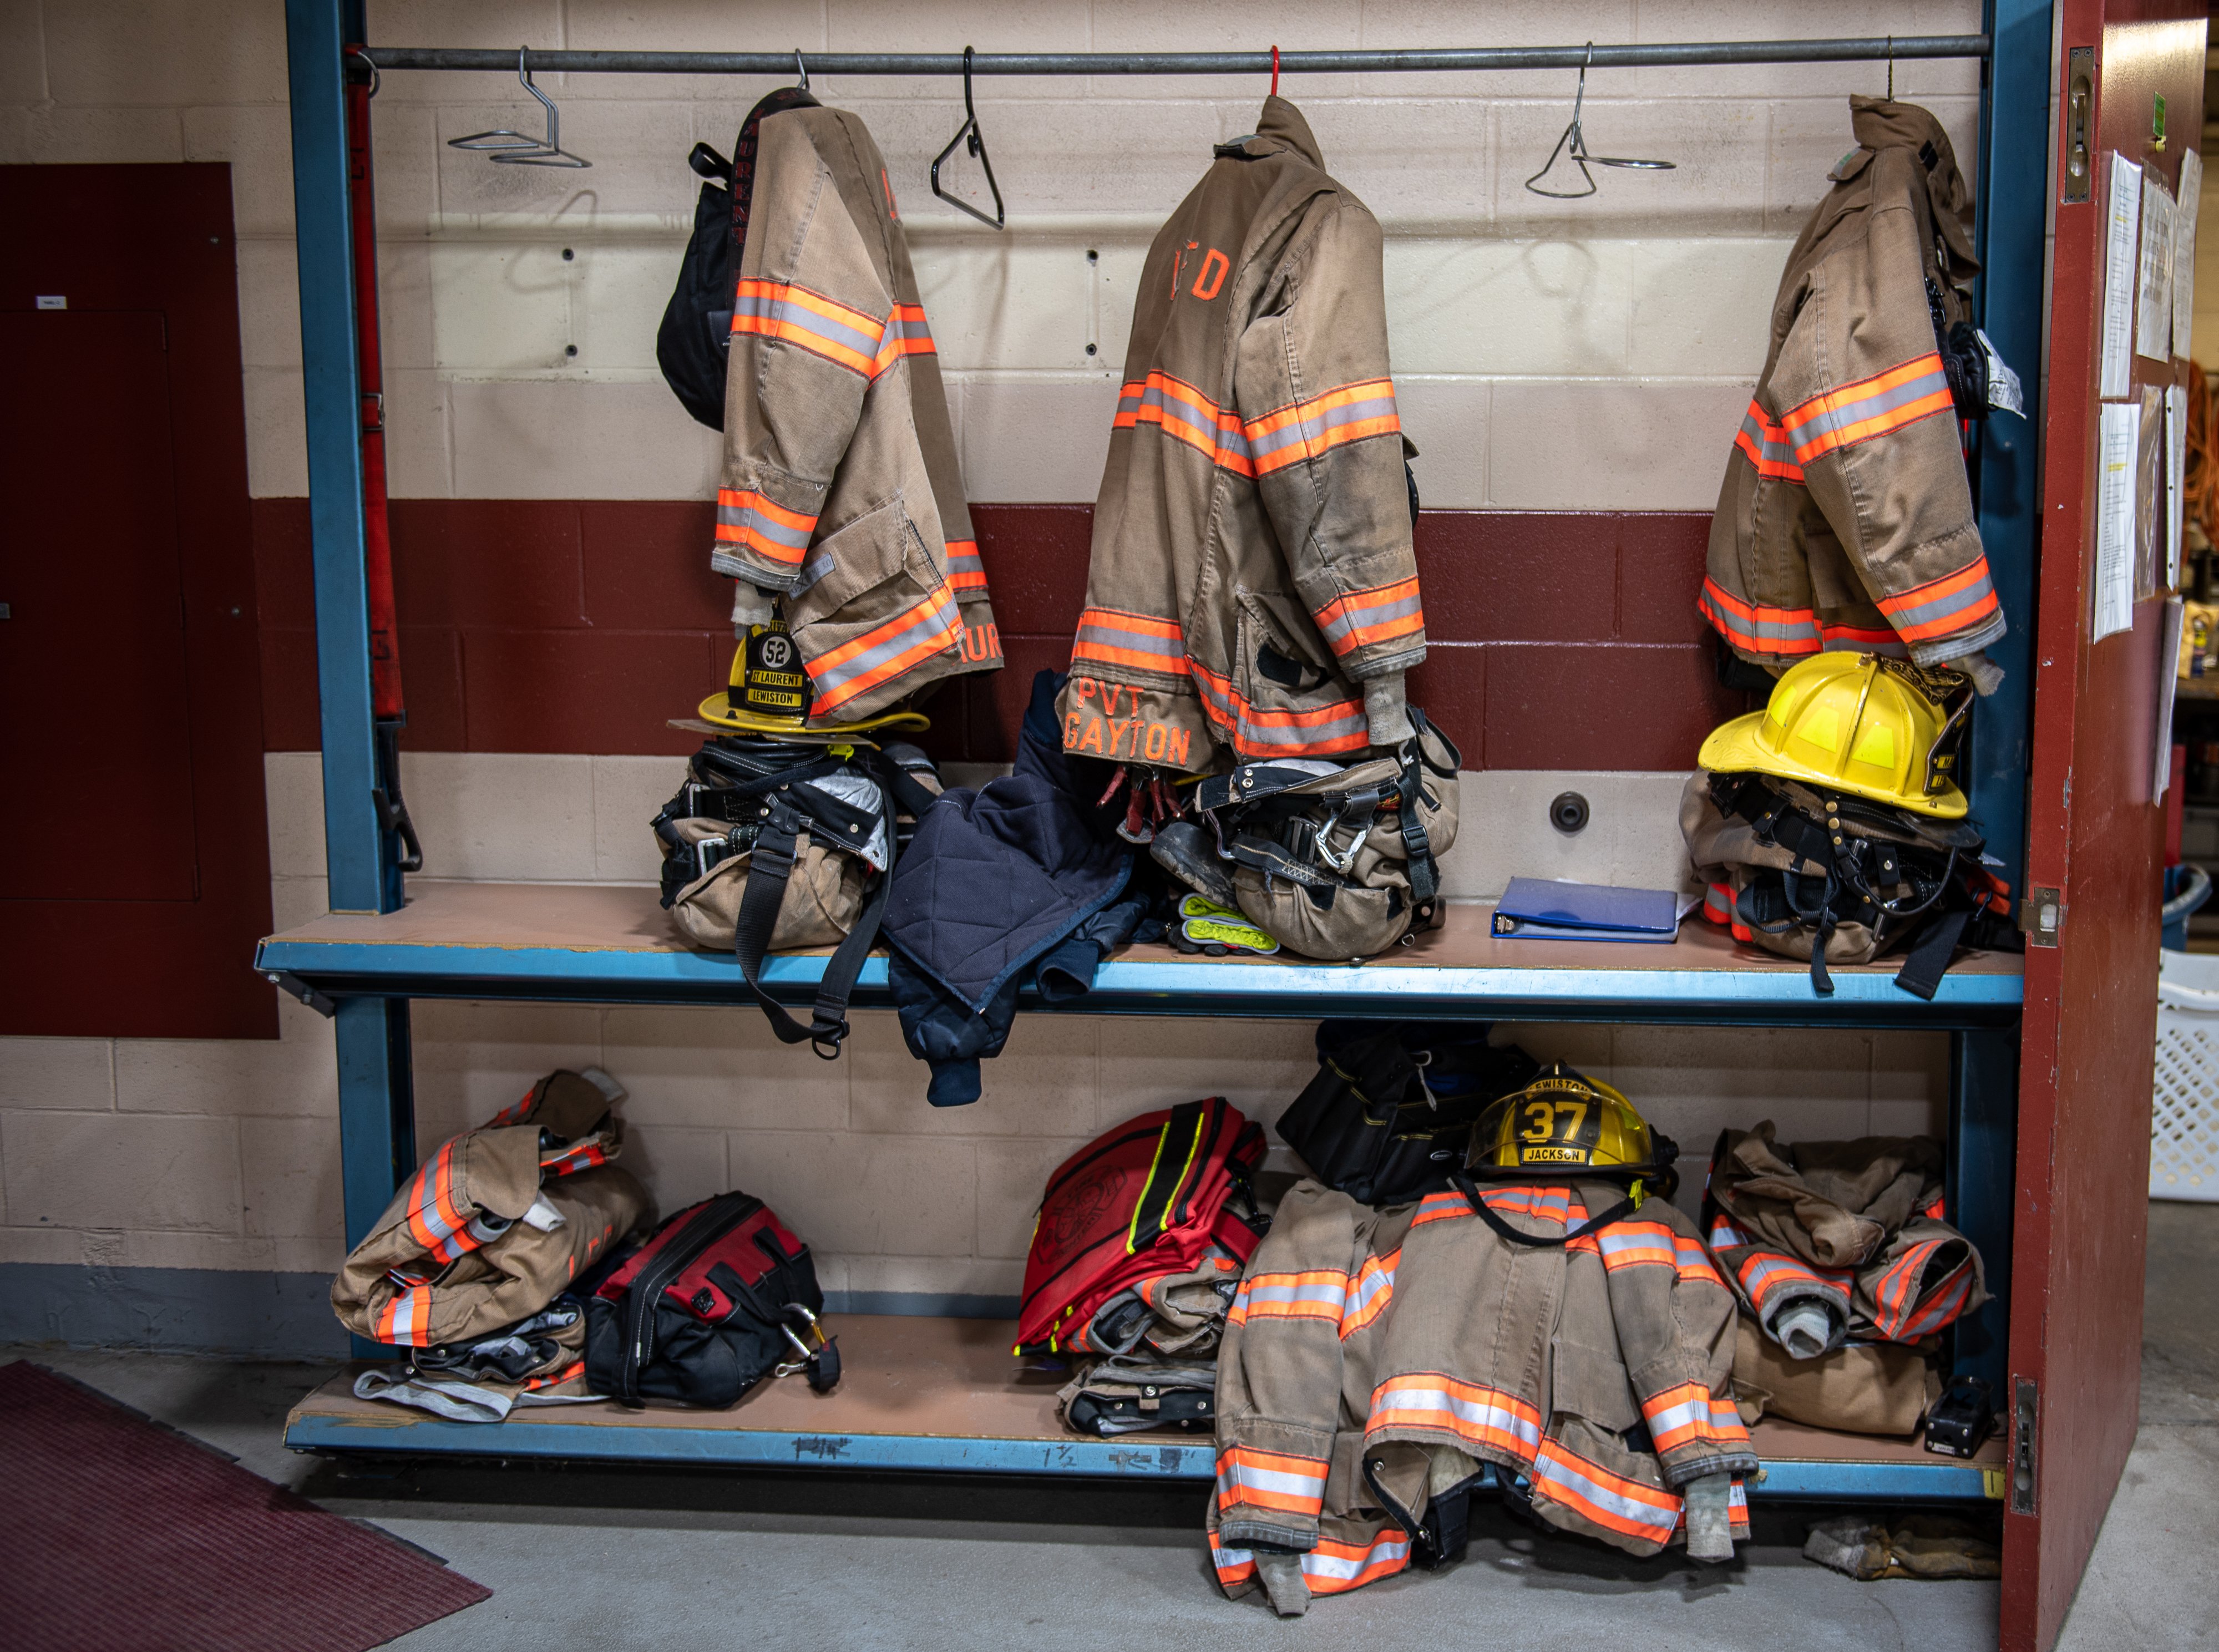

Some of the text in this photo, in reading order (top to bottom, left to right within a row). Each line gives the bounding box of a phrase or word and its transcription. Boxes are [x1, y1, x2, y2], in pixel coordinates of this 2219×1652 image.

[766, 641, 786, 665] 52
[753, 672, 800, 686] ST LAURENT
[753, 690, 793, 705] LEWISTON
[1076, 677, 1144, 718] PVT
[1063, 712, 1192, 766] GAYTON
[1523, 1101, 1587, 1144] 37
[1528, 1149, 1580, 1161] JACKSON
